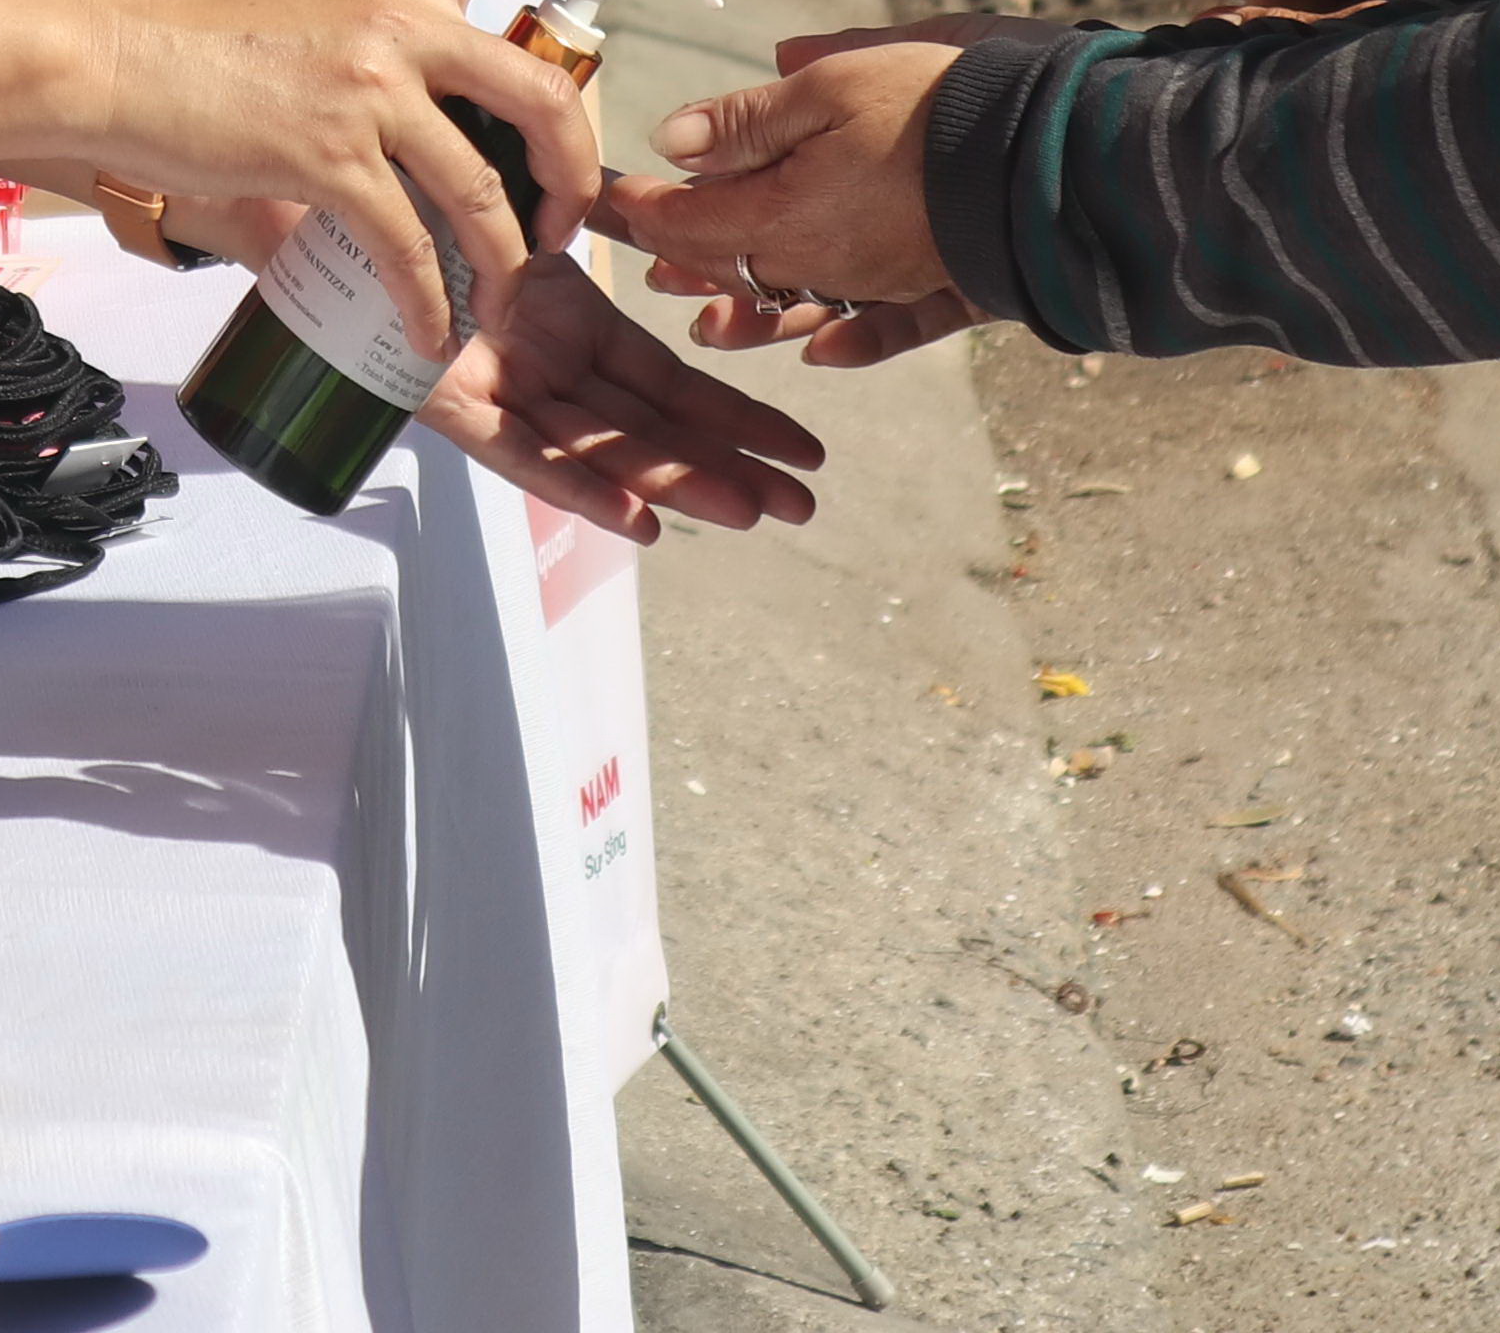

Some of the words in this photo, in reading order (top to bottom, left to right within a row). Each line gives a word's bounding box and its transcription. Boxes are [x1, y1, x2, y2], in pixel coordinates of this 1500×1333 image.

[315, 209, 336, 239] RỬA
[336, 233, 364, 261] TAY
[303, 248, 356, 302] SANITIZER
[579, 754, 622, 828] NAM
